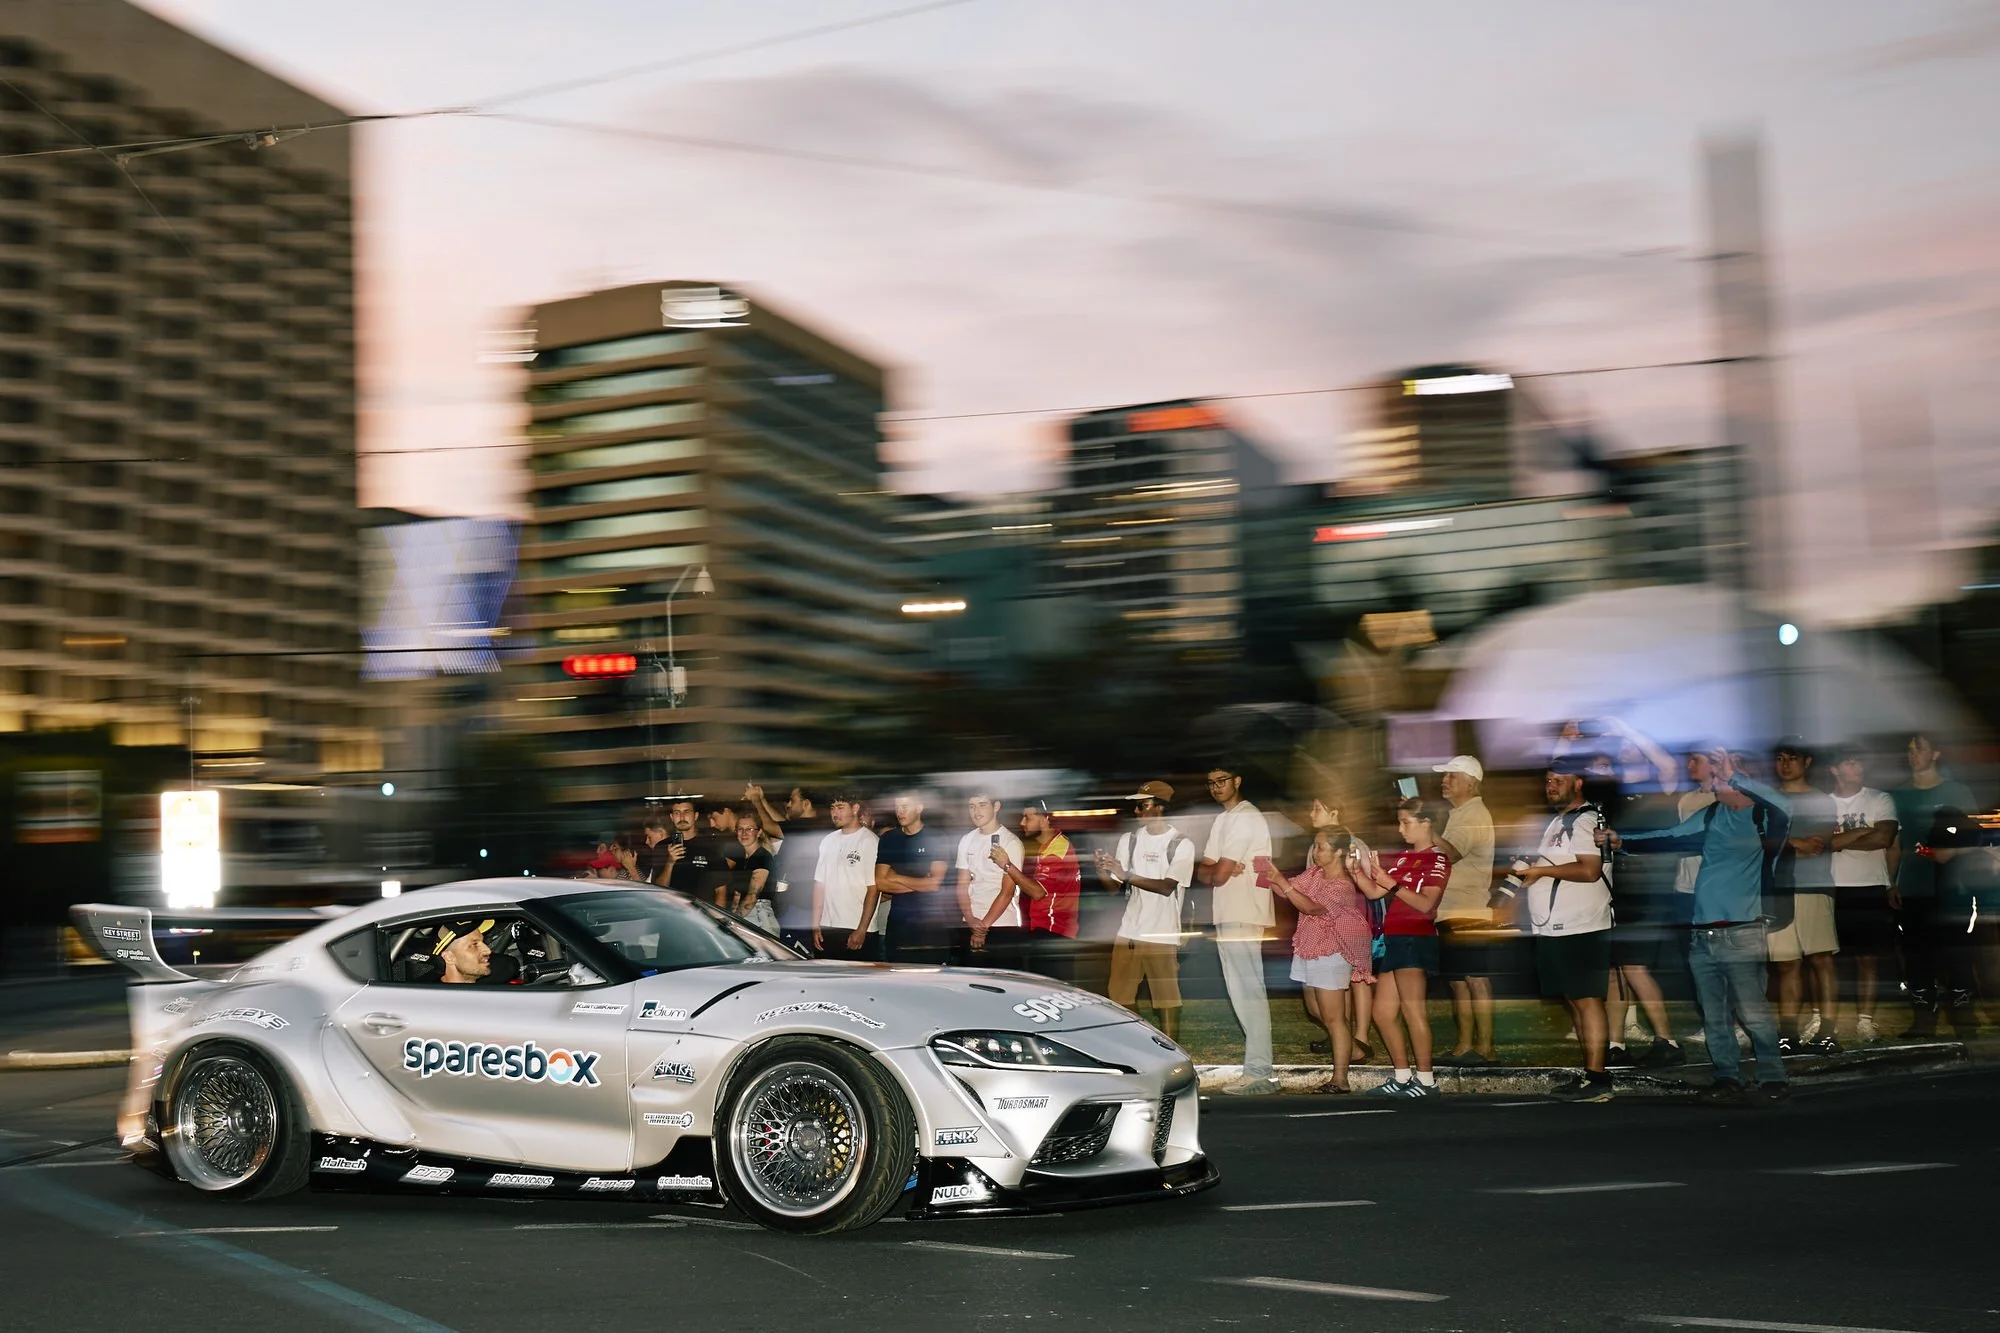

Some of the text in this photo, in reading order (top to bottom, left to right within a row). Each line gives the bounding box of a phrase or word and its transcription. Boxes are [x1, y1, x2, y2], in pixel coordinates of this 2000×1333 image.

[116, 930, 139, 938] STREET
[405, 1038, 599, 1085] sparesbox
[994, 1096, 1049, 1110] TURBOSMART
[936, 1130, 977, 1141] FENIX
[321, 1158, 366, 1169] Haltech
